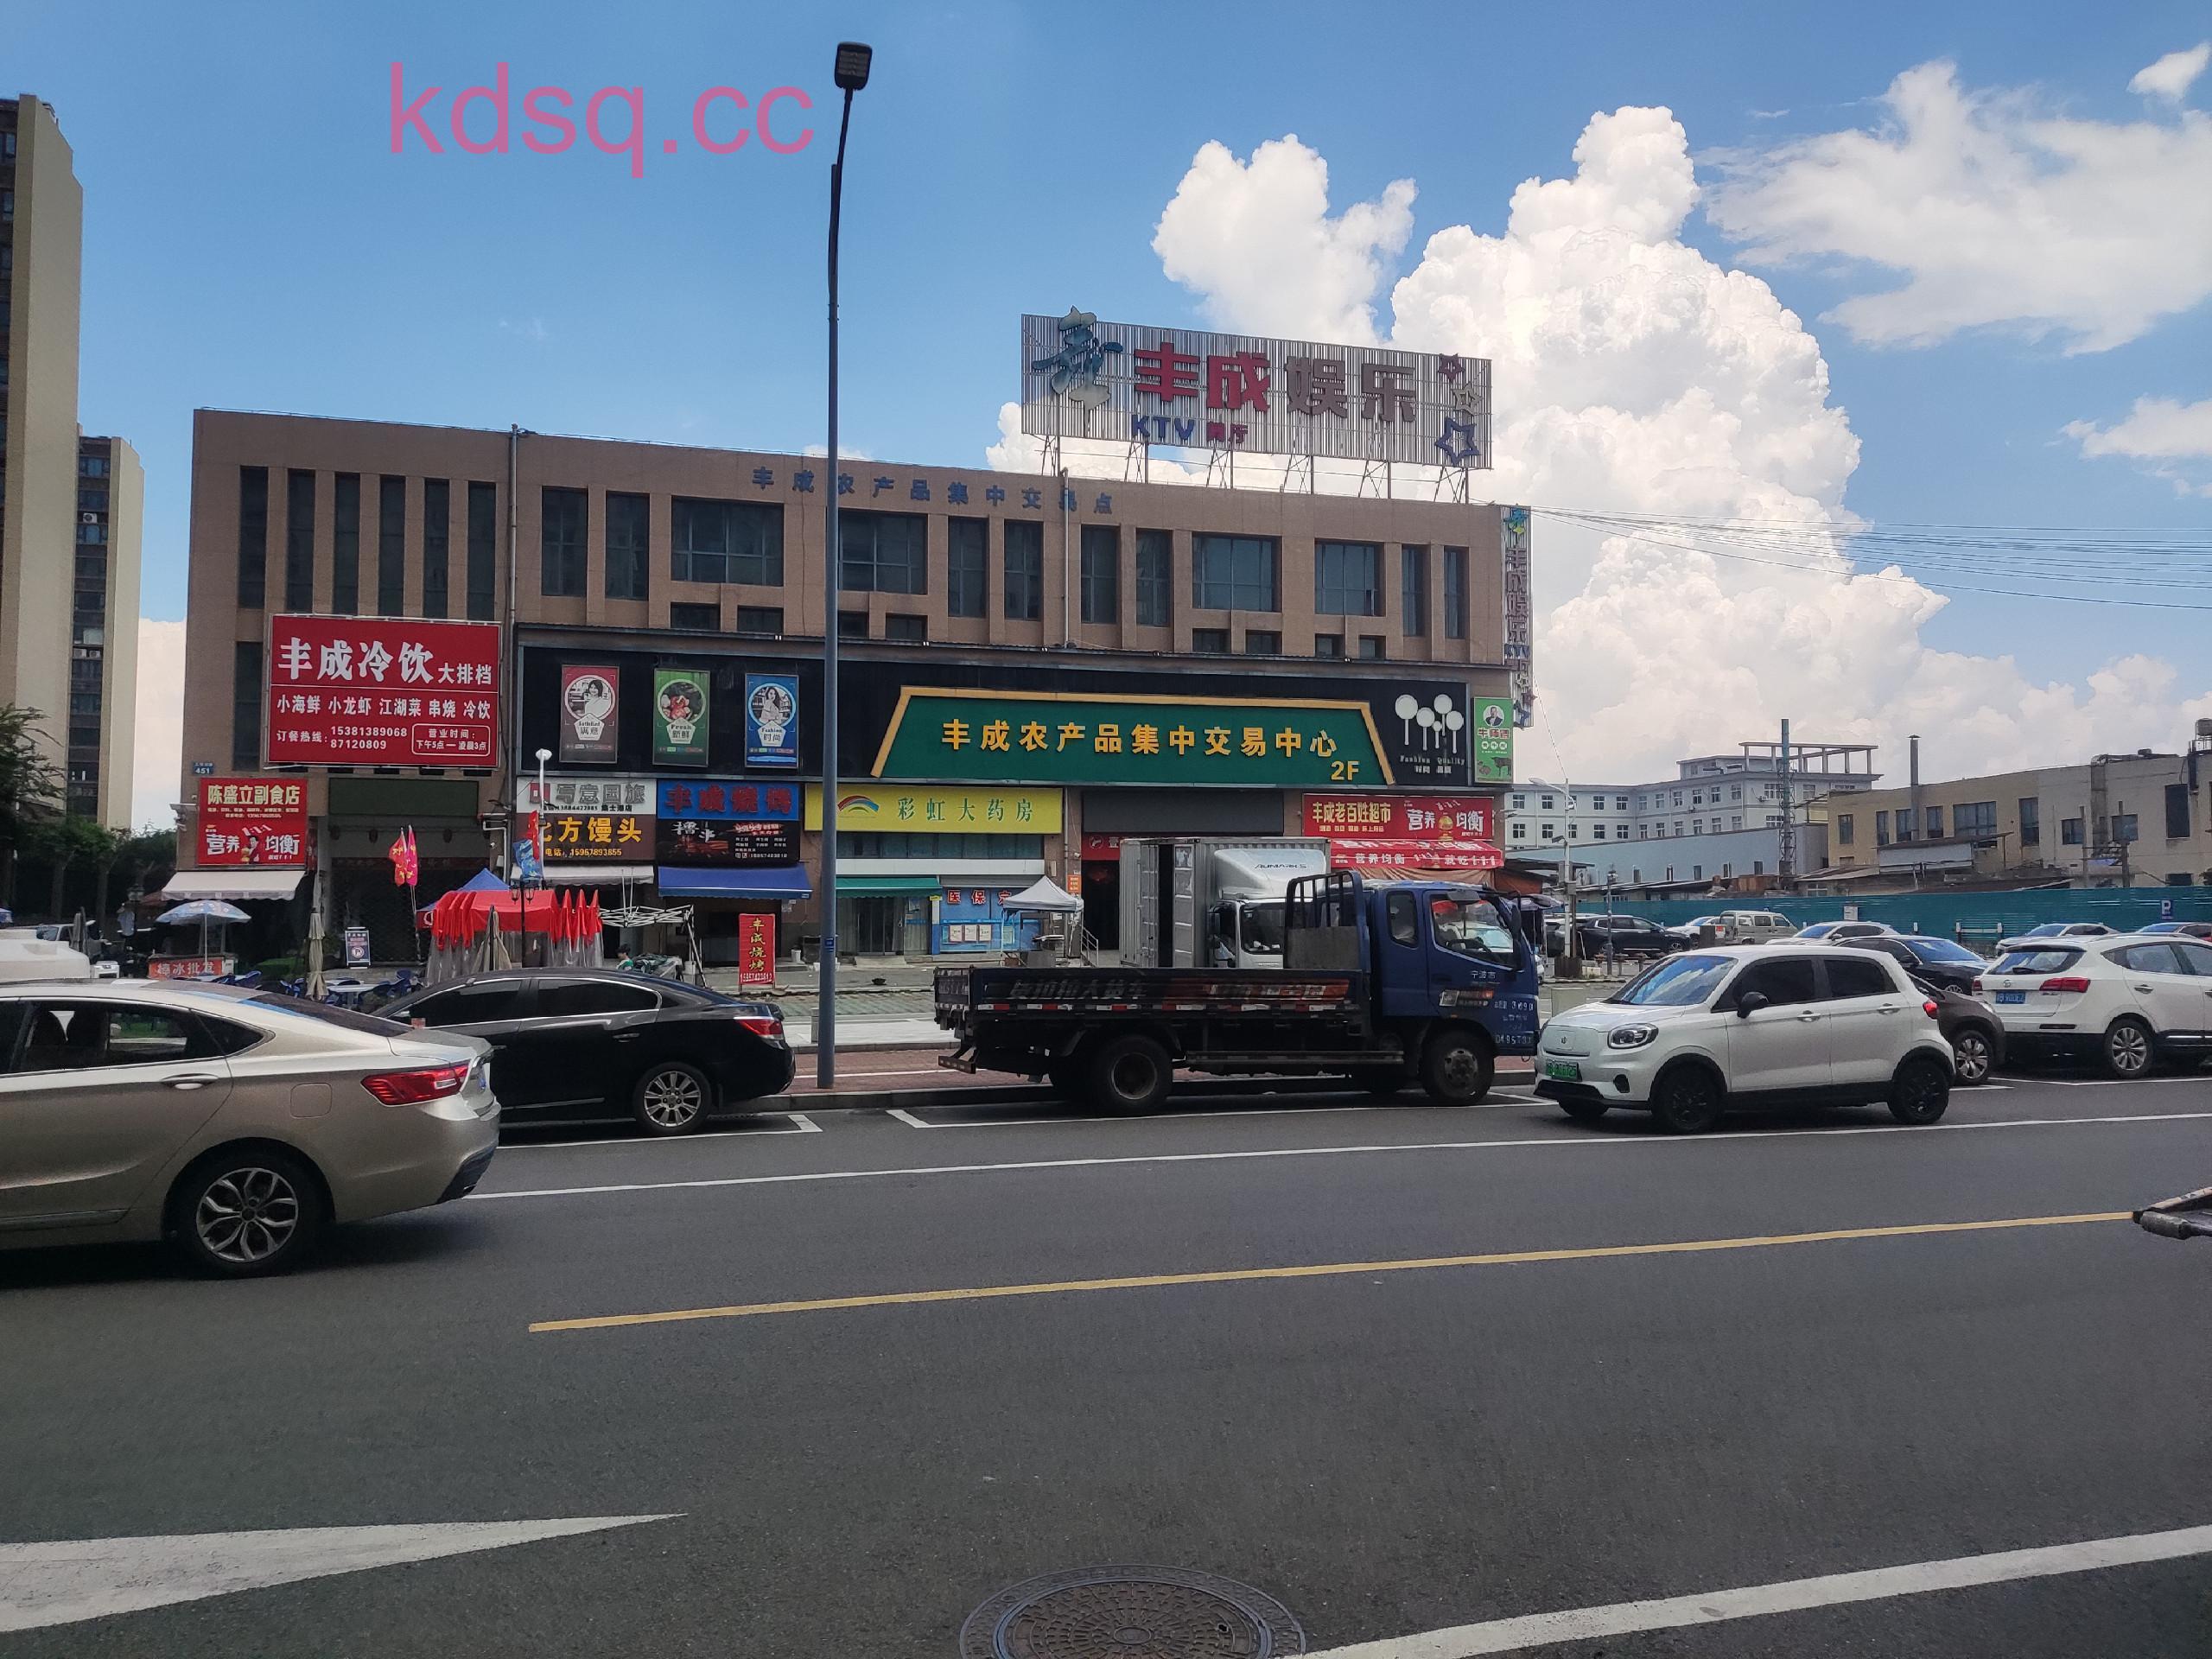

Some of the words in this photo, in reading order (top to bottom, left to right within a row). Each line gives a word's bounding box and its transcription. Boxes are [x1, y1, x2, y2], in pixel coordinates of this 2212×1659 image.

[1134, 341, 1417, 423] 丰成娱乐
[1131, 415, 1195, 441] KTV
[752, 466, 1112, 514] 丰成农产品集中交易点
[277, 637, 434, 683] 丰成冷饮
[438, 663, 493, 684] 大排档
[276, 695, 321, 714] 小海鲜
[328, 696, 372, 716] 小龙虾
[379, 698, 422, 717] 江湖菜
[429, 699, 457, 719] 串烧
[463, 700, 491, 720] 冷饮
[331, 726, 408, 737] 15381389068
[942, 718, 1338, 758] 丰成农产品集中交易中心
[330, 739, 387, 750] 87120809
[1331, 760, 1359, 781] 2F
[207, 785, 301, 804] 陈盛立副食店
[555, 783, 645, 804] 写意国旅
[898, 797, 1034, 823] 彩虹大药房
[1313, 802, 1391, 823] 丰成老百姓超市
[1407, 809, 1435, 830] 营养
[1456, 810, 1484, 833] 均衡
[206, 834, 239, 855] 营养
[265, 835, 300, 855] 均衡
[1355, 853, 1405, 865] 营养均衡
[748, 918, 767, 972] 丰成烧烤
